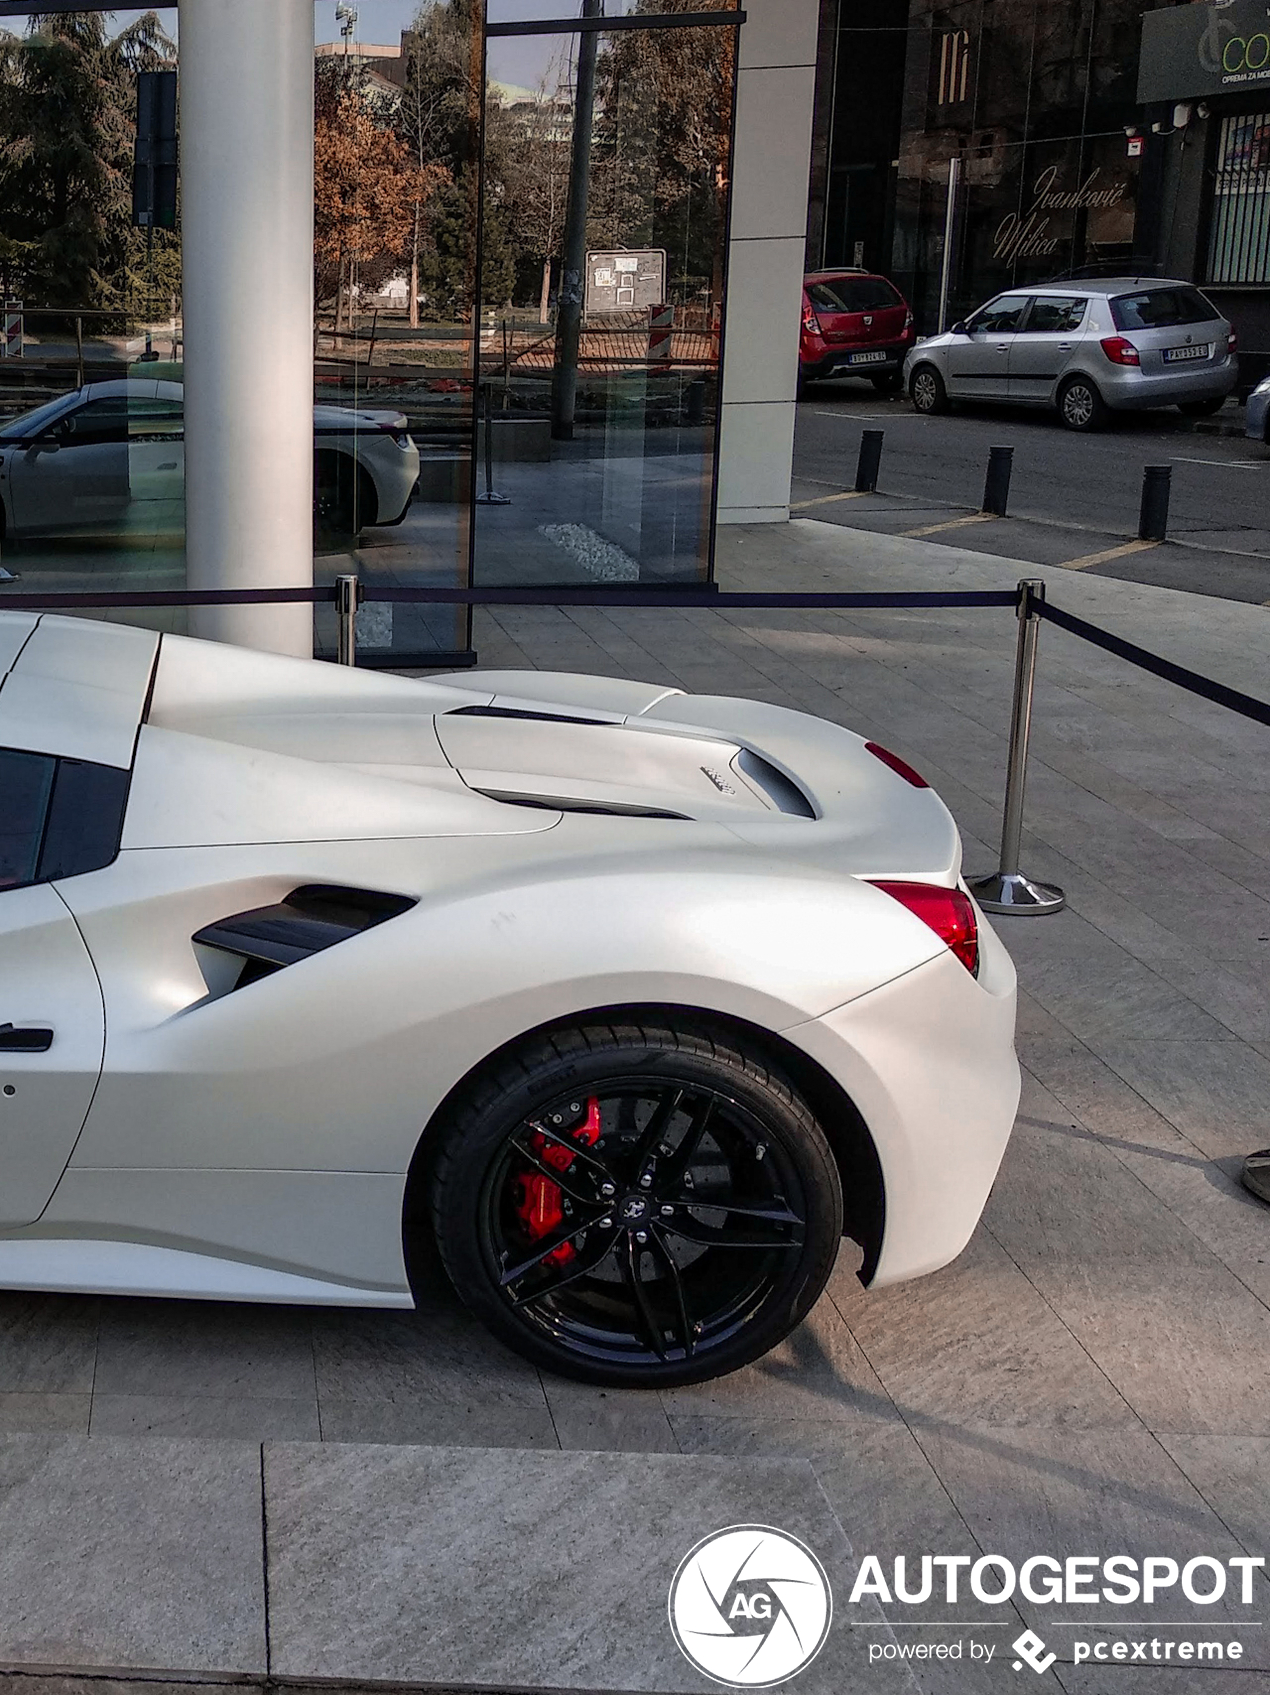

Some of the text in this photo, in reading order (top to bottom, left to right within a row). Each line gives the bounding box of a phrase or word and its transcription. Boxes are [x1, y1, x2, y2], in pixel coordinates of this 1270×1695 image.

[1222, 73, 1247, 84] OPREMA
[1248, 71, 1256, 81] ZA
[992, 211, 1058, 269] Milica
